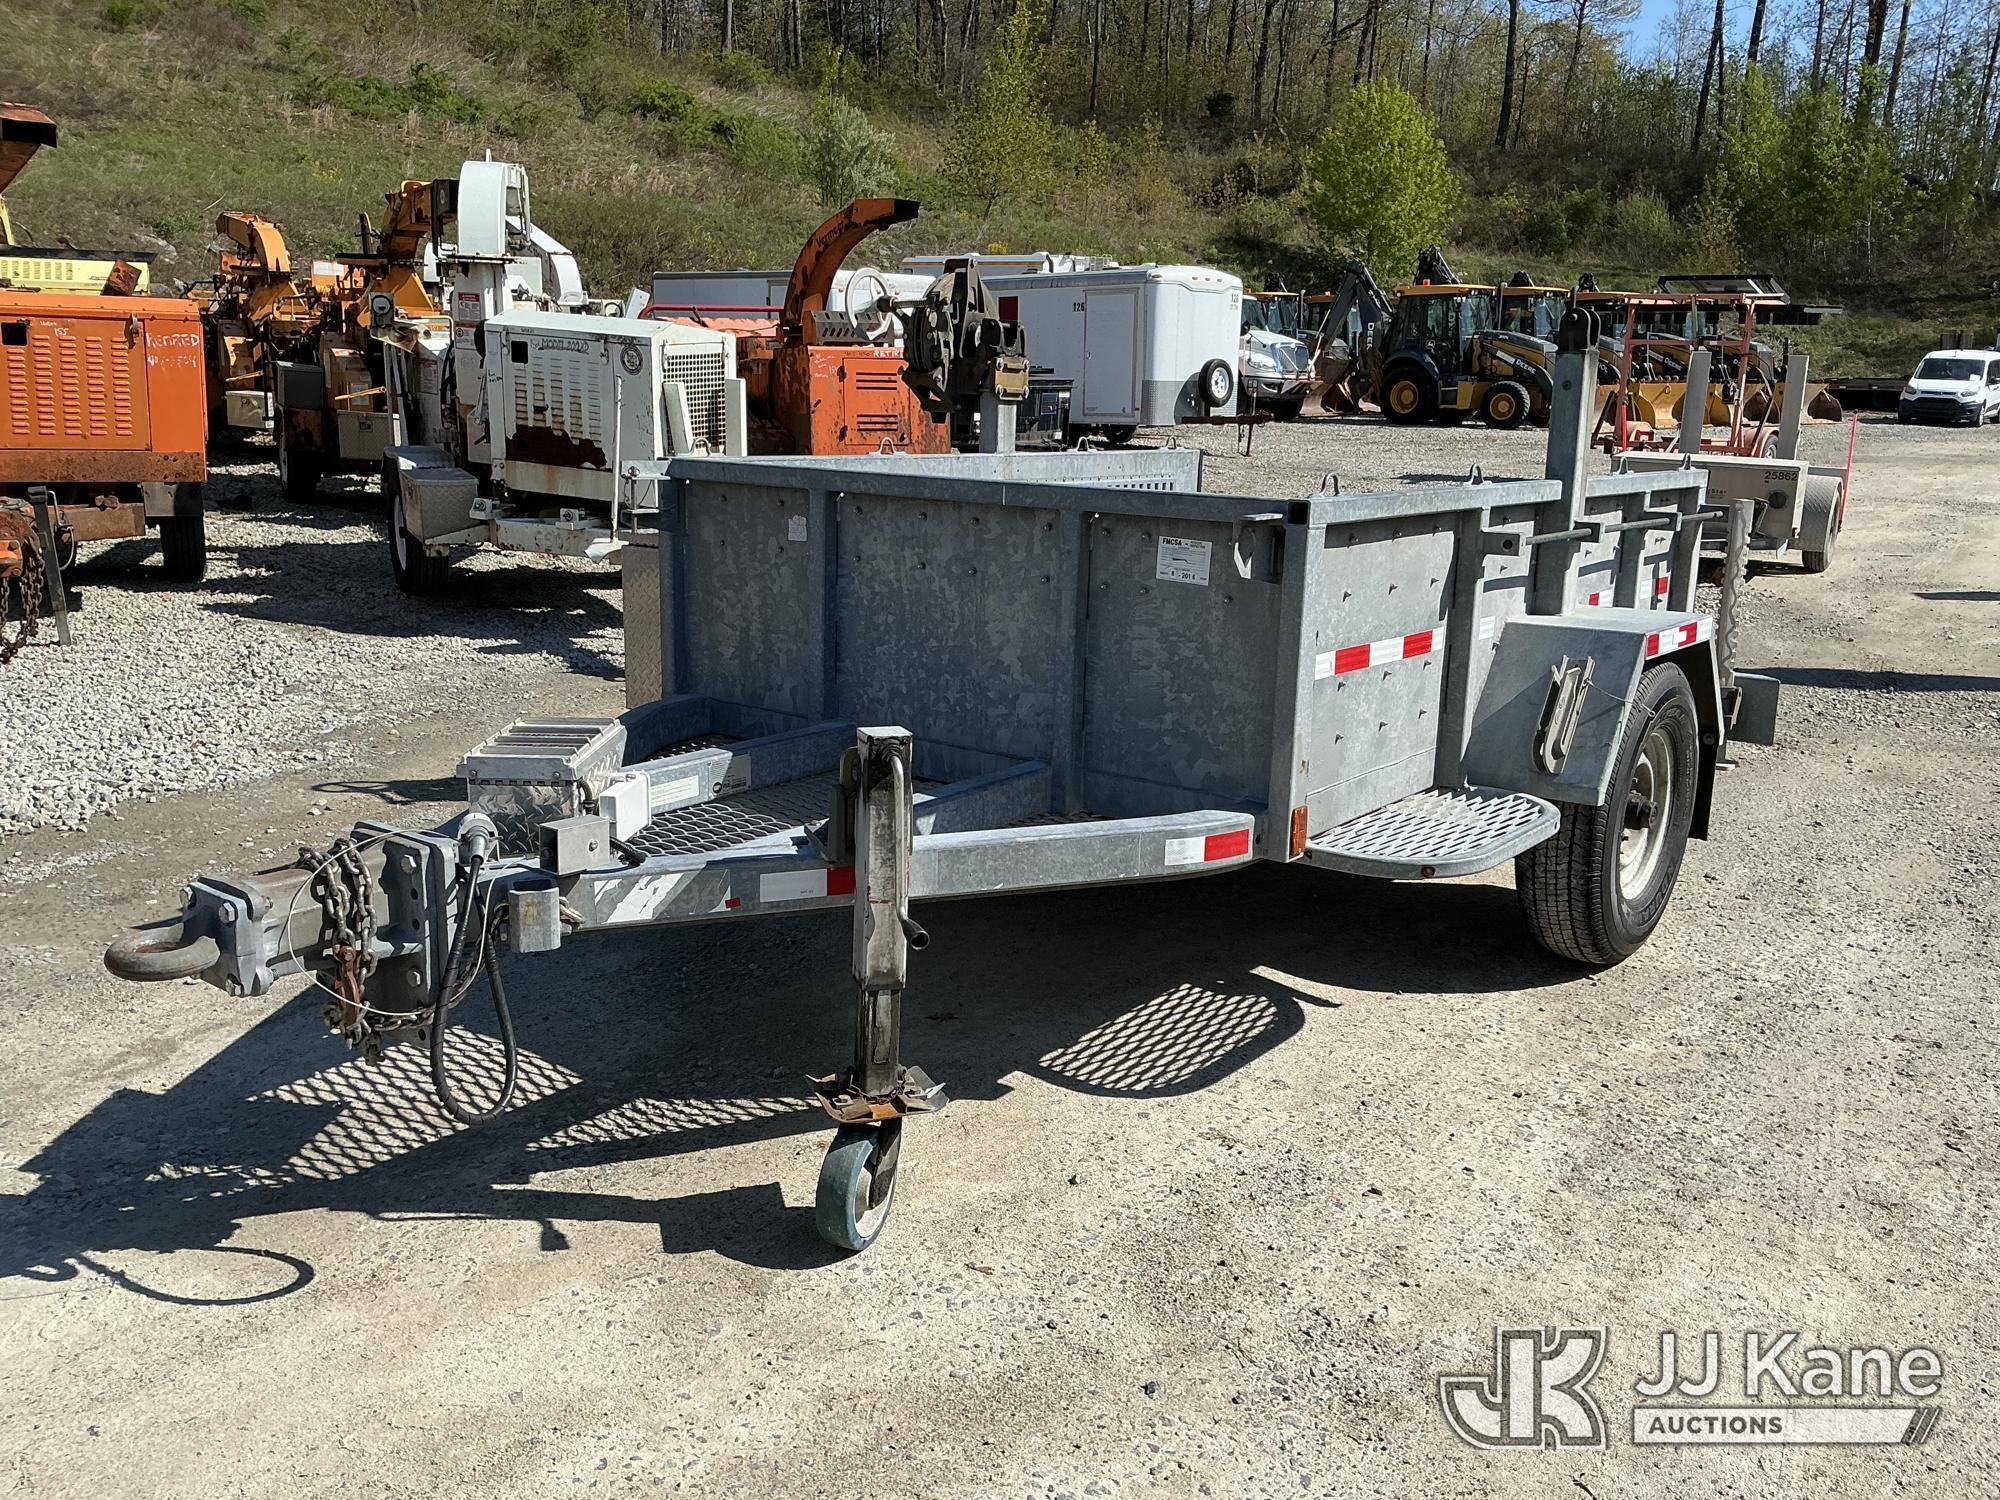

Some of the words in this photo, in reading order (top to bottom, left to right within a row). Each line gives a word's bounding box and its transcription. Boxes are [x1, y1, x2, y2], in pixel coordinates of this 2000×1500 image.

[1073, 302, 1085, 312] 126
[1366, 322, 1375, 352] DEER
[1515, 358, 1537, 375] DEERE
[1764, 470, 1799, 481] 25862
[1162, 538, 1182, 546] FMCSA
